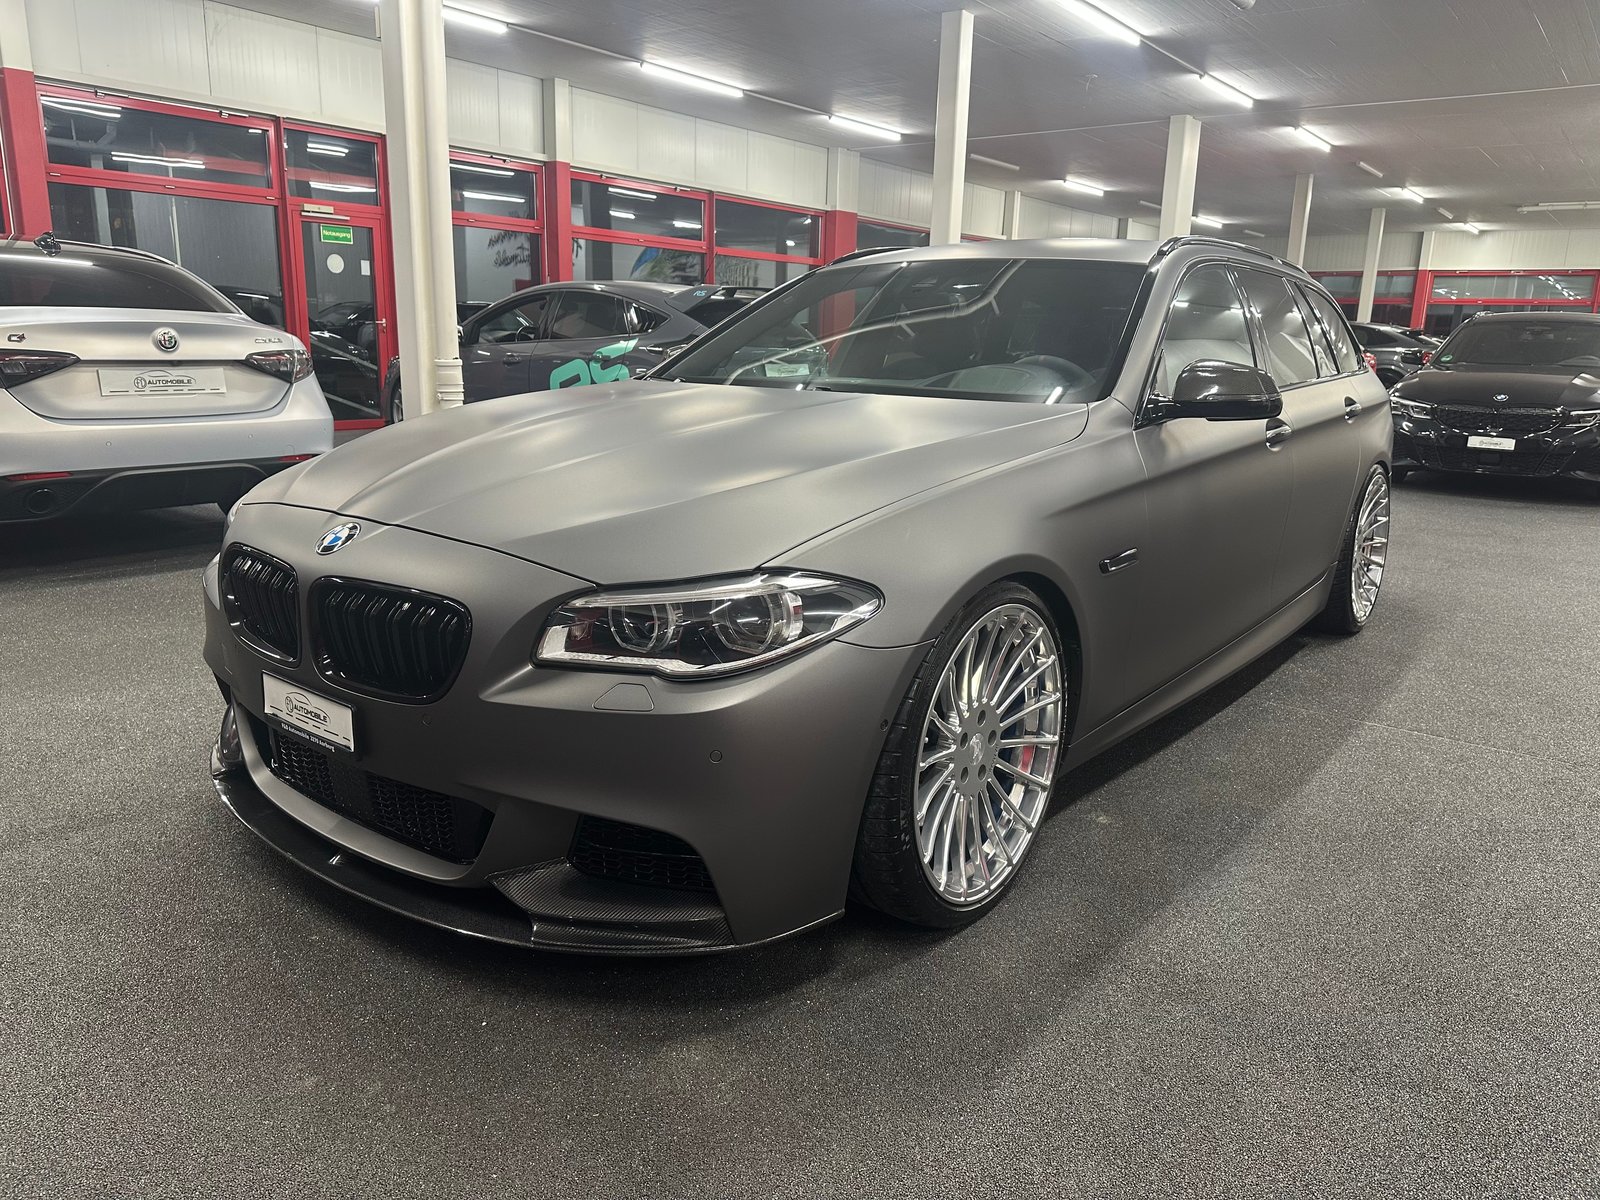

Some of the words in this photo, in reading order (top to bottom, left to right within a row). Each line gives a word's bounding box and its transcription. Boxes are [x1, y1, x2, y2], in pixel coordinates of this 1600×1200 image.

[323, 230, 351, 239] Notausgang
[294, 704, 328, 723] AUTOMOBILE
[288, 726, 310, 740] Automobile
